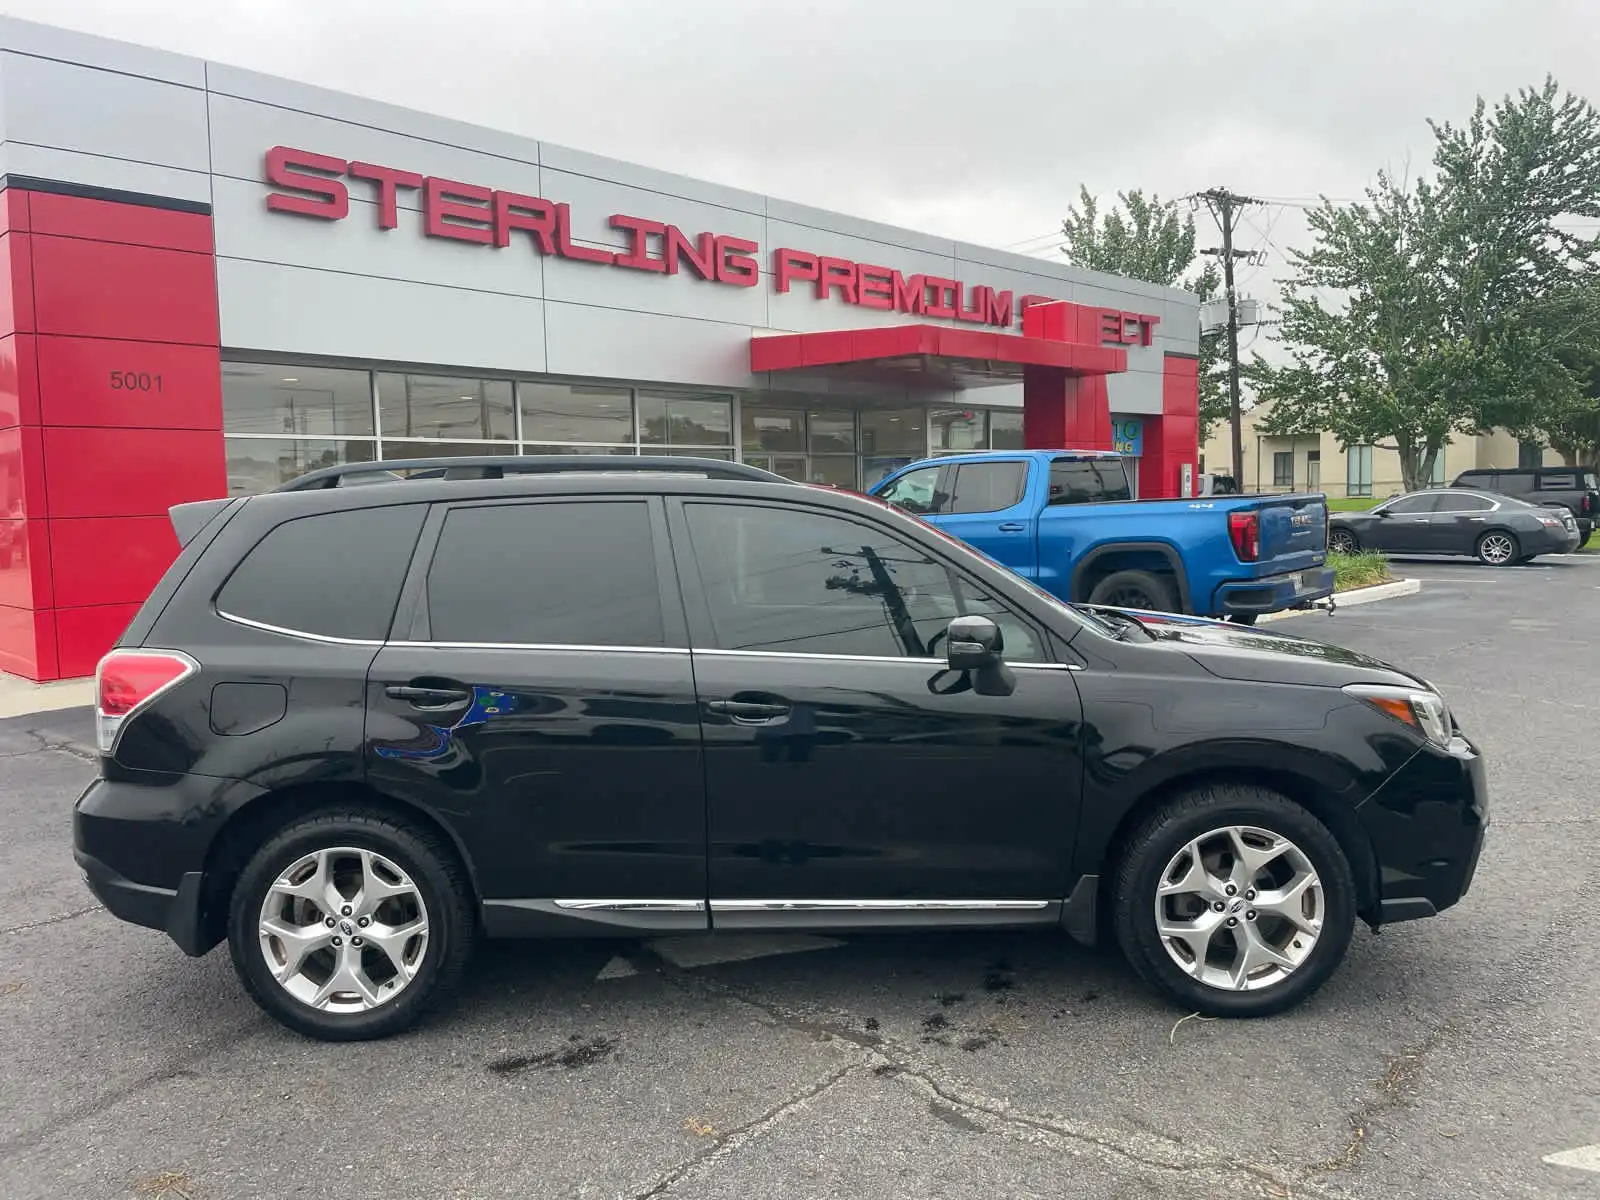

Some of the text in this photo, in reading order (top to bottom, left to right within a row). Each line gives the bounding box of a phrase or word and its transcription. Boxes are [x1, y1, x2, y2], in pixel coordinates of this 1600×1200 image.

[266, 145, 759, 287] STERLING
[774, 247, 1013, 327] PREMIUM
[109, 370, 163, 393] 5001
